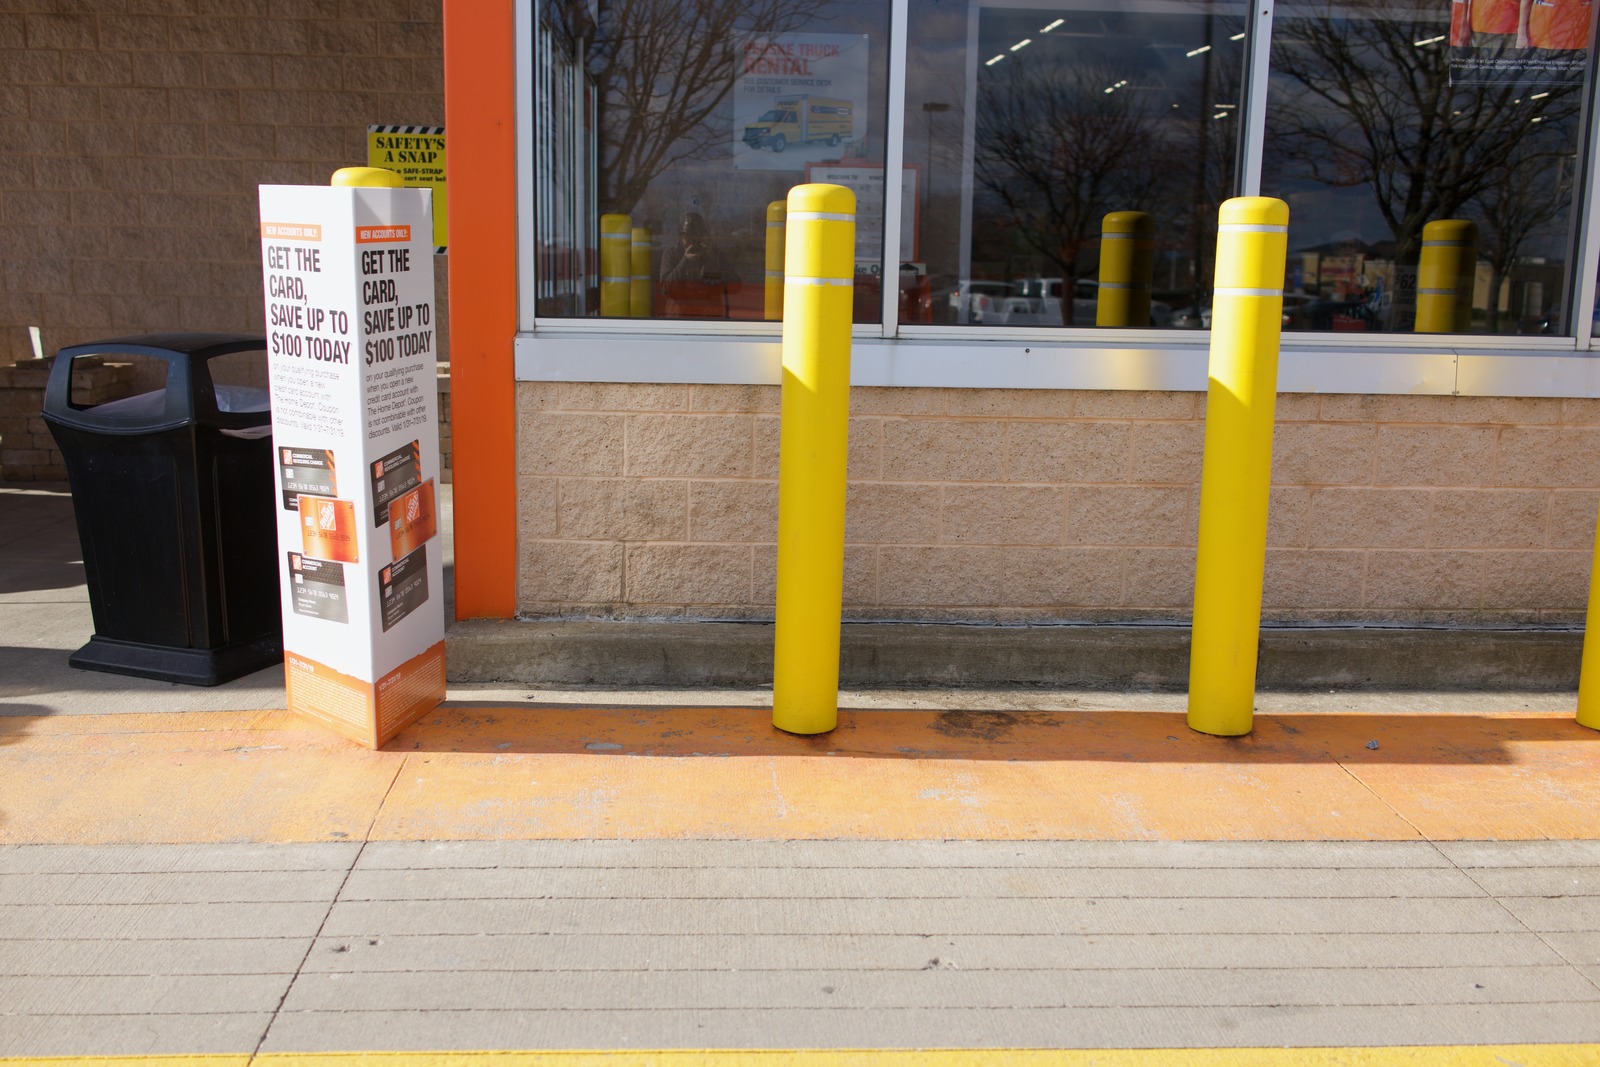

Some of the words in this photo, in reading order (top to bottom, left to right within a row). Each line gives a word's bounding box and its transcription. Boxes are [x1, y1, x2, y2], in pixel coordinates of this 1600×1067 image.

[744, 41, 794, 56] PENSKE
[798, 44, 840, 56] TRUCK
[743, 57, 812, 76] RENTAL
[384, 151, 394, 162] A
[398, 151, 437, 163] SNAP
[266, 226, 276, 235] NEW
[278, 226, 302, 237] ACCOUNTS
[360, 230, 371, 239] NEW
[372, 230, 395, 239] ACCOUNTS
[268, 246, 290, 270] GET
[295, 248, 321, 272] THE
[362, 250, 384, 275] GET
[388, 249, 410, 272] THE
[270, 274, 308, 305] CARD,
[363, 279, 398, 306] CARD,
[271, 303, 303, 329] SAVE
[307, 307, 324, 331] UP
[329, 310, 348, 335] TO
[364, 308, 395, 335] SAVE
[398, 306, 413, 330] UP
[416, 303, 430, 326] TO
[272, 330, 302, 357] $100
[365, 339, 394, 367] $100
[373, 372, 383, 382] your
[384, 368, 404, 379] qualifying
[405, 363, 424, 374] purchase
[367, 384, 379, 393] when
[380, 384, 388, 392] you
[390, 380, 400, 389] open
[367, 395, 380, 405] credit
[381, 392, 391, 401] card
[392, 388, 408, 399] account
[368, 408, 376, 416] The
[378, 404, 390, 414] Home
[408, 396, 424, 406] Coupon
[382, 411, 406, 424] combinable
[407, 408, 415, 416] with
[416, 405, 426, 414] other
[369, 427, 390, 439] discounts.
[392, 423, 402, 432] Valid
